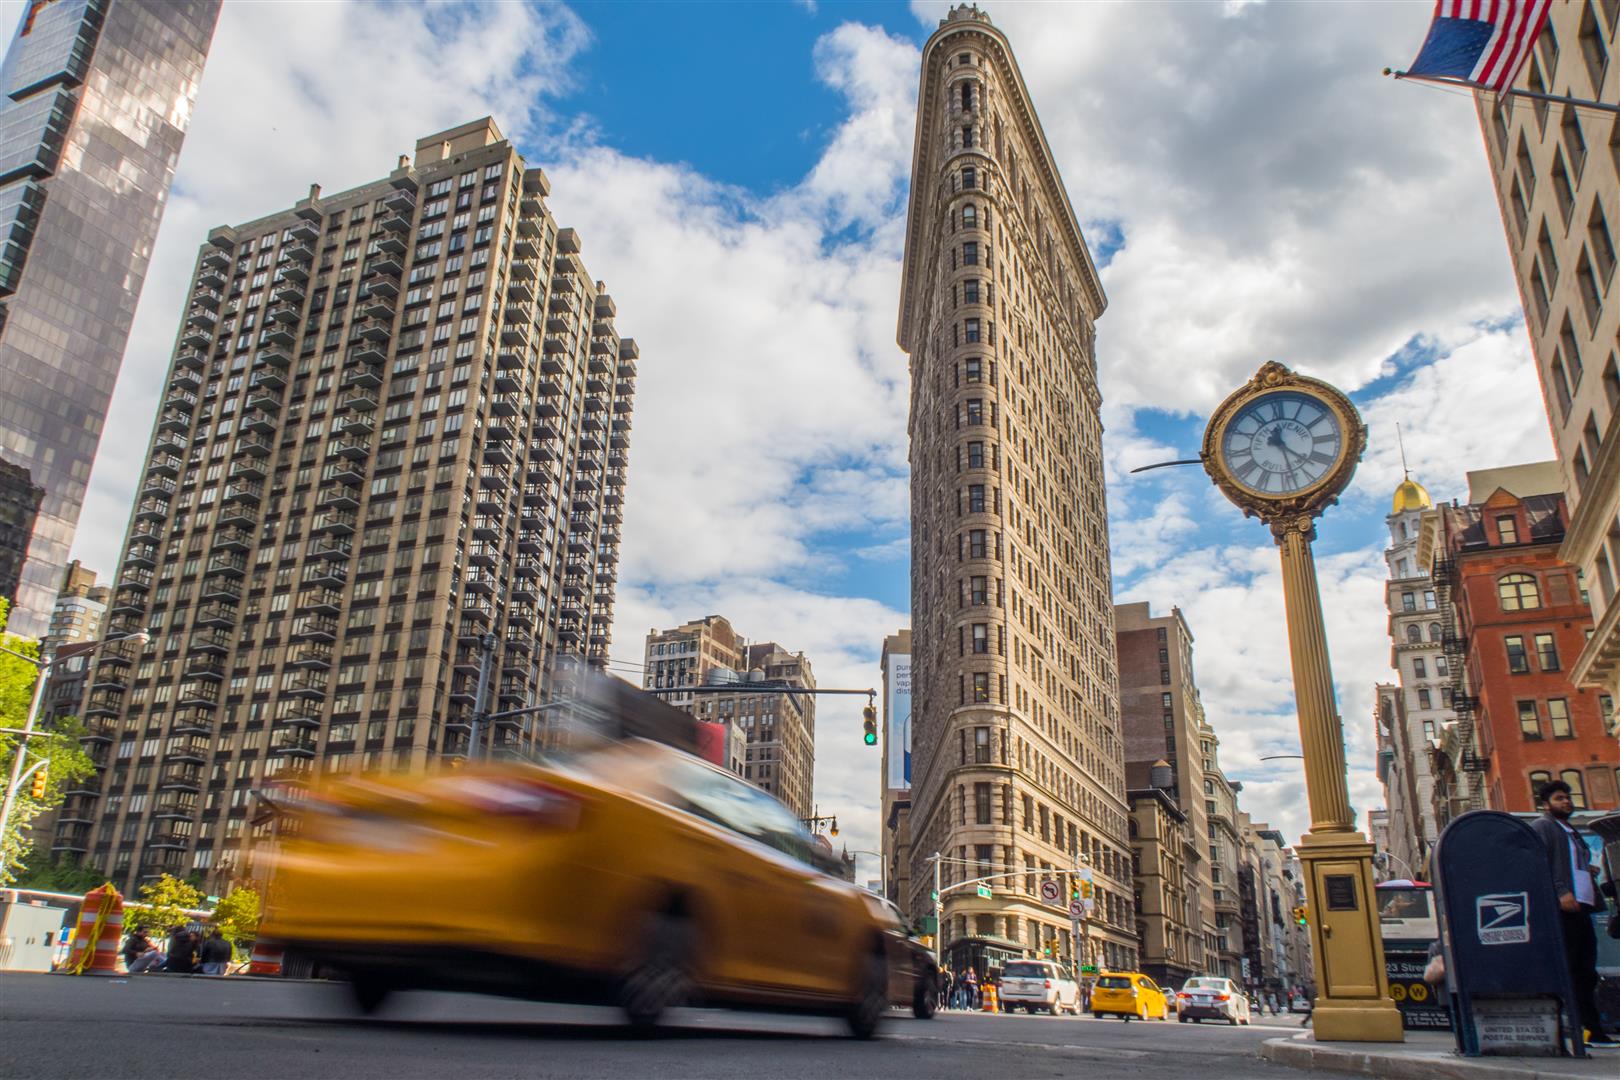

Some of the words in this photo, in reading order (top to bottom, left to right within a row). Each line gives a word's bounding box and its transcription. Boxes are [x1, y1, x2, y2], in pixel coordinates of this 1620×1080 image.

[1253, 426, 1272, 451] FIFTH
[1385, 963, 1398, 972] 23
[1401, 963, 1424, 972] Stree
